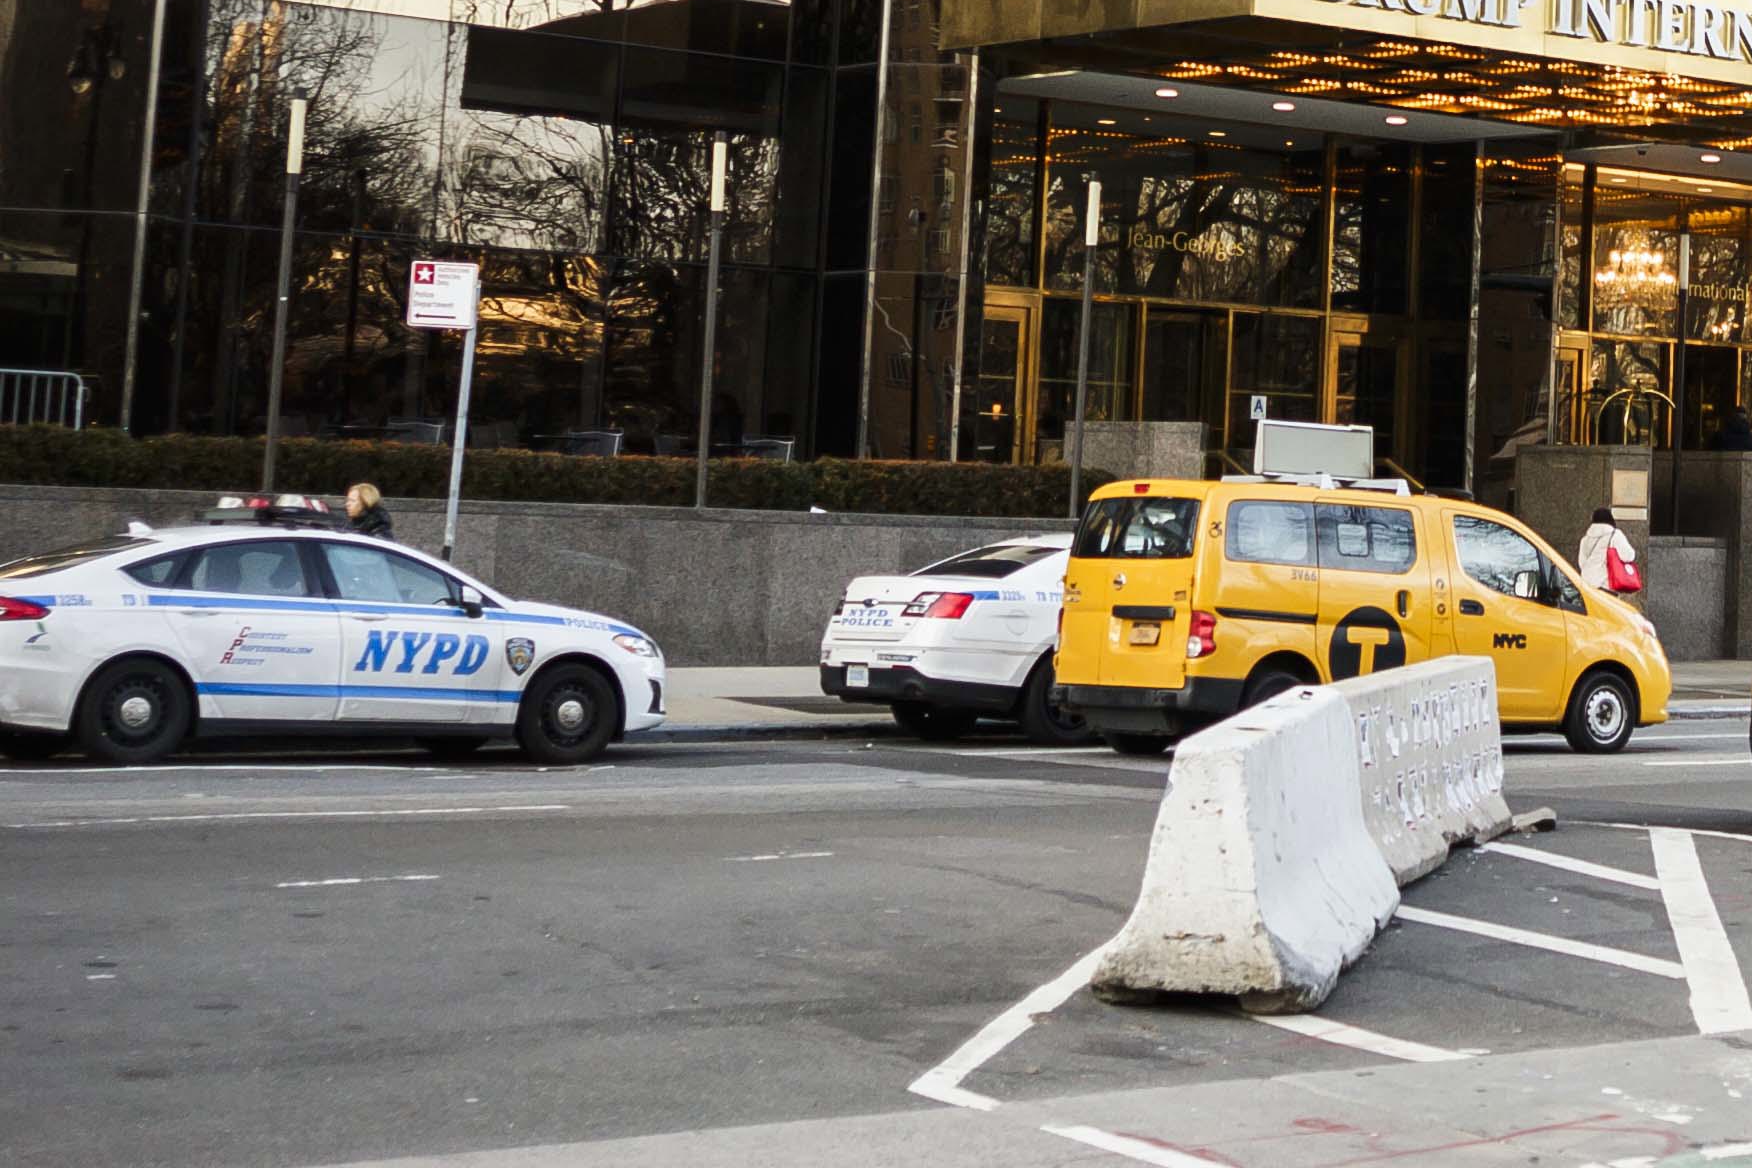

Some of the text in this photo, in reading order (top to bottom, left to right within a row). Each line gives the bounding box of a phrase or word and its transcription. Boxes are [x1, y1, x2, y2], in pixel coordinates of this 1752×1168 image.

[1127, 226, 1245, 262] Jean-Georges
[1254, 399, 1264, 413] A
[848, 608, 889, 618] NYPD
[841, 618, 894, 627] POLICE
[1493, 633, 1527, 650] NYC
[353, 630, 490, 675] NYPD
